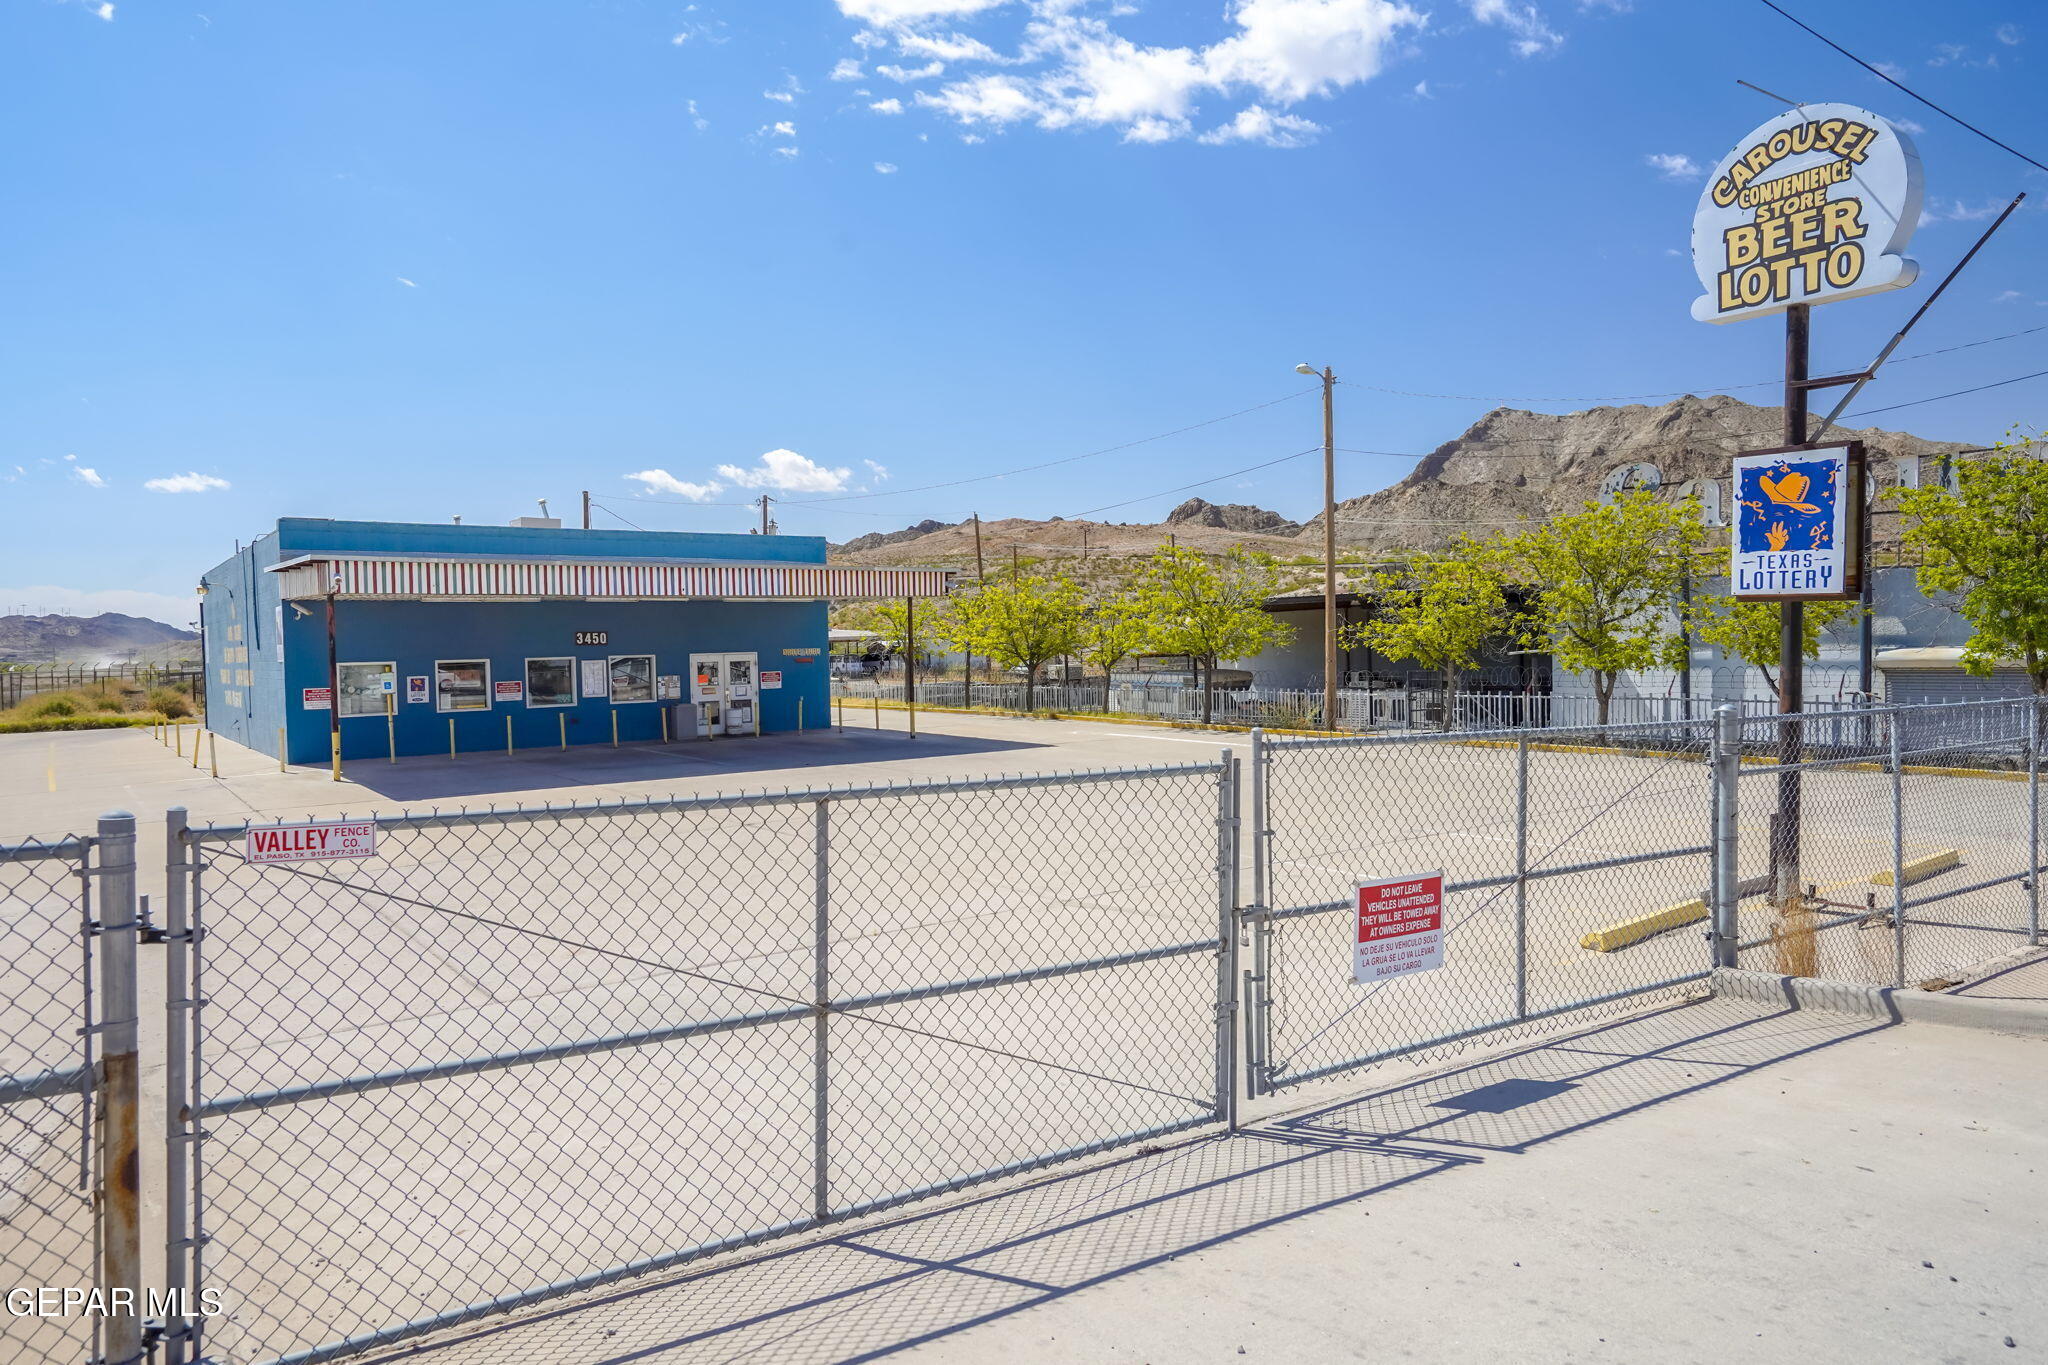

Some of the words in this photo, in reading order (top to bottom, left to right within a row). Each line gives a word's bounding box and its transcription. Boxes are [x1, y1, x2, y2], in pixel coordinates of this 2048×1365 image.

[1712, 117, 1879, 208] CAROUSEL
[1738, 159, 1852, 209] CONVENIENCE
[1756, 188, 1827, 223] STORE
[1723, 197, 1868, 268] BEER
[1718, 241, 1864, 312] LOTTO
[1757, 554, 1812, 569] TEXAS
[1740, 566, 1832, 589] LOTTERY
[577, 633, 606, 644] 3450
[254, 829, 329, 852] VALLEY
[334, 826, 369, 837] FENCE
[343, 839, 360, 848] CO.
[311, 848, 369, 857] 915-877-3115
[1382, 888, 1390, 897] DO
[1391, 886, 1404, 896] NOT
[1405, 883, 1422, 894] LEAVE
[1368, 900, 1396, 912] VEHICLES
[1398, 894, 1434, 908] UNATTENDED
[1361, 915, 1378, 926] THEY
[1378, 914, 1392, 923] WILL
[1394, 911, 1402, 920] BE
[1403, 908, 1423, 919] TOWED
[1424, 905, 1439, 915] AWAY
[1370, 927, 1378, 938] AT
[1379, 923, 1404, 935] OWNERS
[1406, 918, 1431, 931] EXPENSE
[1360, 947, 1368, 956] NO
[1370, 944, 1384, 954] DEJE
[1385, 943, 1393, 951] SU
[1395, 937, 1422, 949] VEHICULO
[1423, 935, 1437, 943] SOLO
[1362, 958, 1370, 967] LA
[1371, 956, 1387, 966] GRUA
[1388, 954, 1396, 962] SE
[1398, 952, 1405, 960] LO
[1407, 949, 1414, 958] VA
[1415, 946, 1435, 957] LLEVAR
[1377, 965, 1392, 975] BAJO
[1393, 963, 1400, 972] SU
[1402, 960, 1421, 971] CARGO
